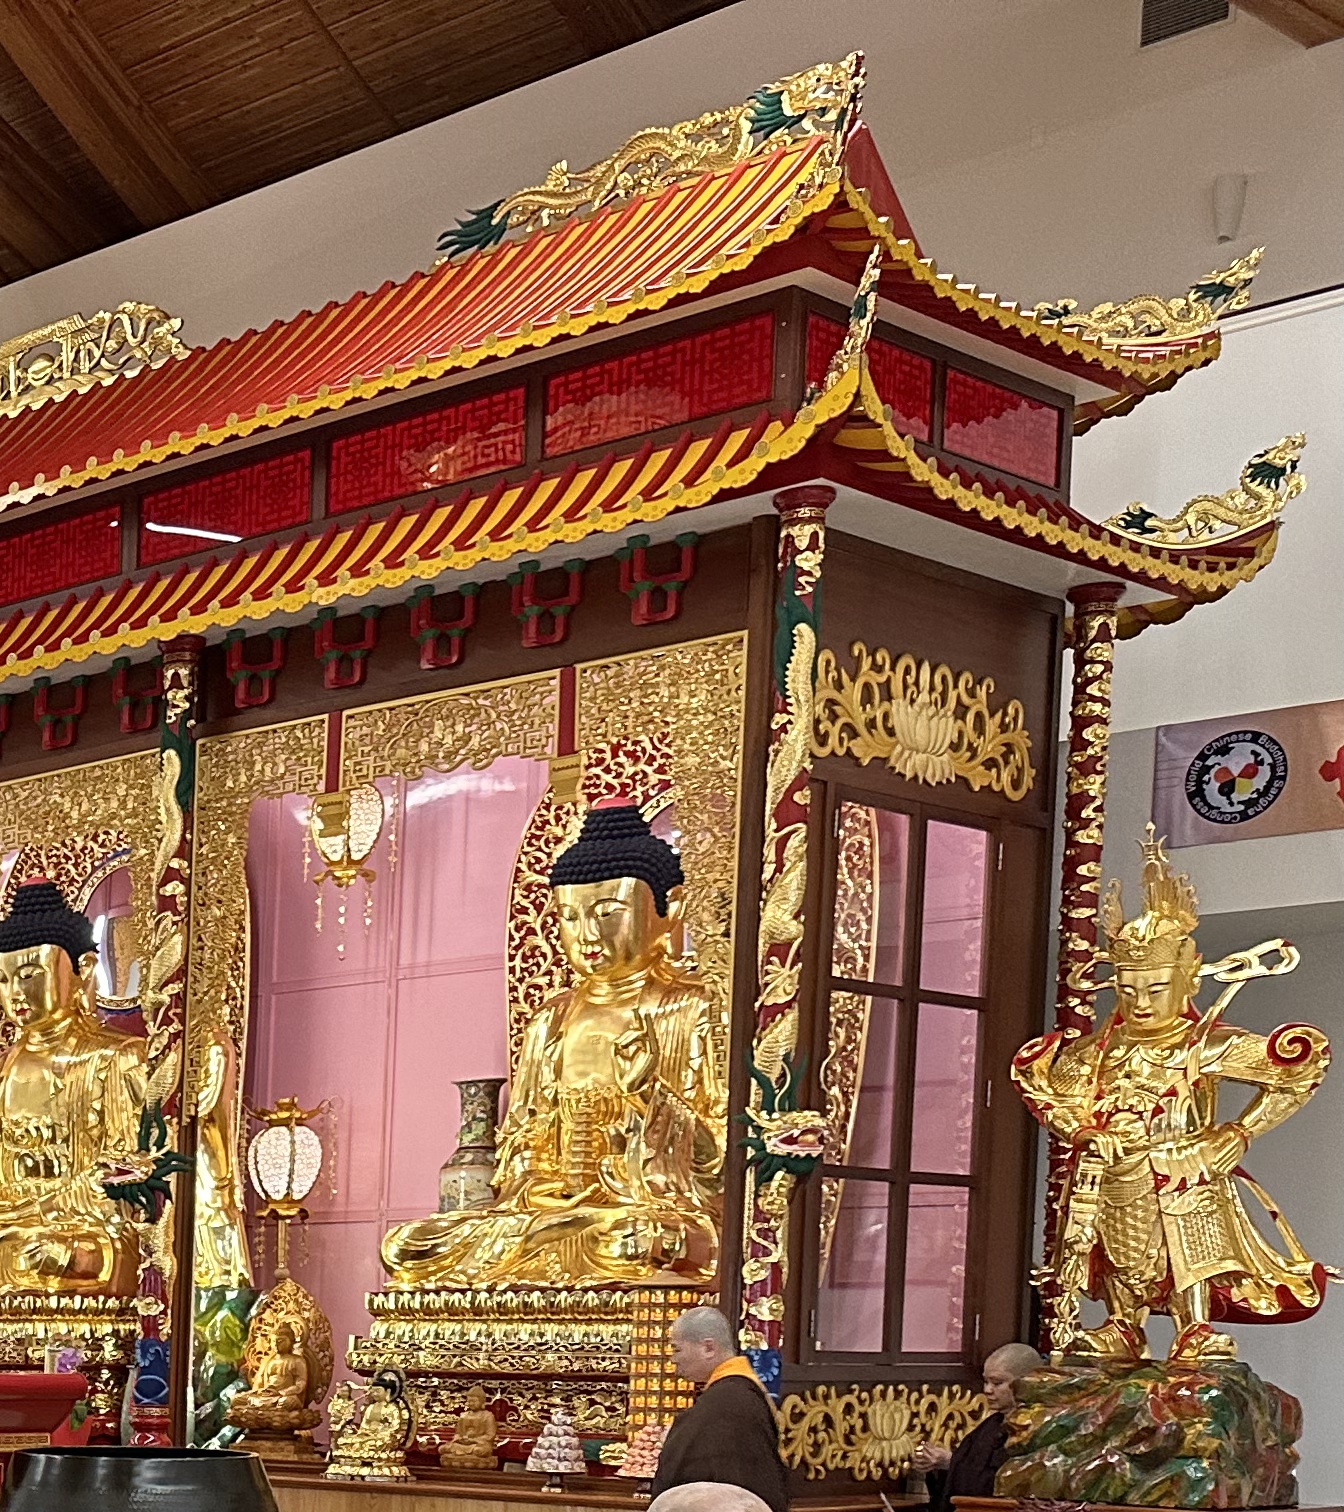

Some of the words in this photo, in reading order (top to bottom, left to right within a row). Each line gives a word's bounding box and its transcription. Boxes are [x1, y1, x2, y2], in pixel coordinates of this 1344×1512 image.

[1204, 732, 1253, 755] Chinese
[1257, 734, 1286, 777] Buddhist
[1186, 759, 1203, 793] World
[1191, 797, 1242, 824] Congress
[1247, 779, 1285, 817] Sangha
